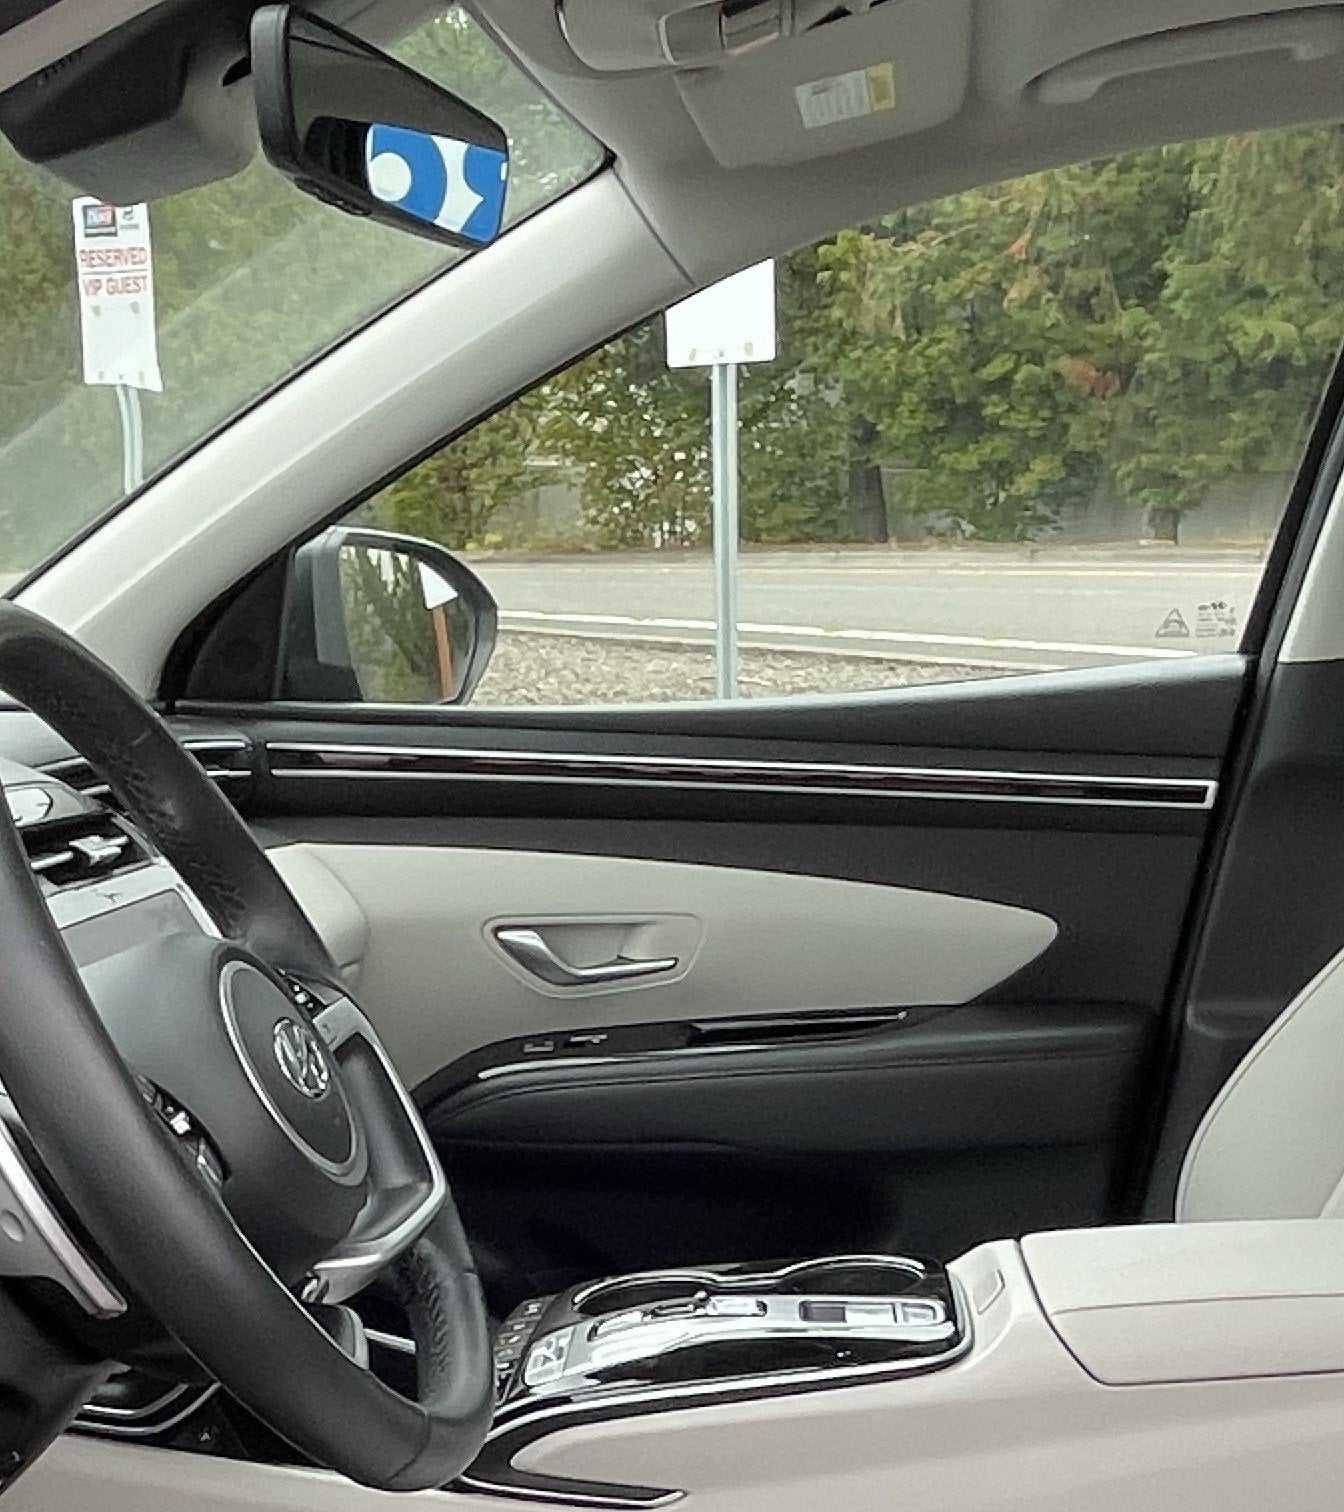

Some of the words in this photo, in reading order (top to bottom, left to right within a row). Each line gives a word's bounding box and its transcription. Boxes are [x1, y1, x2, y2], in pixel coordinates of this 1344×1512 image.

[78, 246, 146, 268] RESERVED
[83, 278, 103, 297] VIP
[105, 274, 148, 295] GUEST
